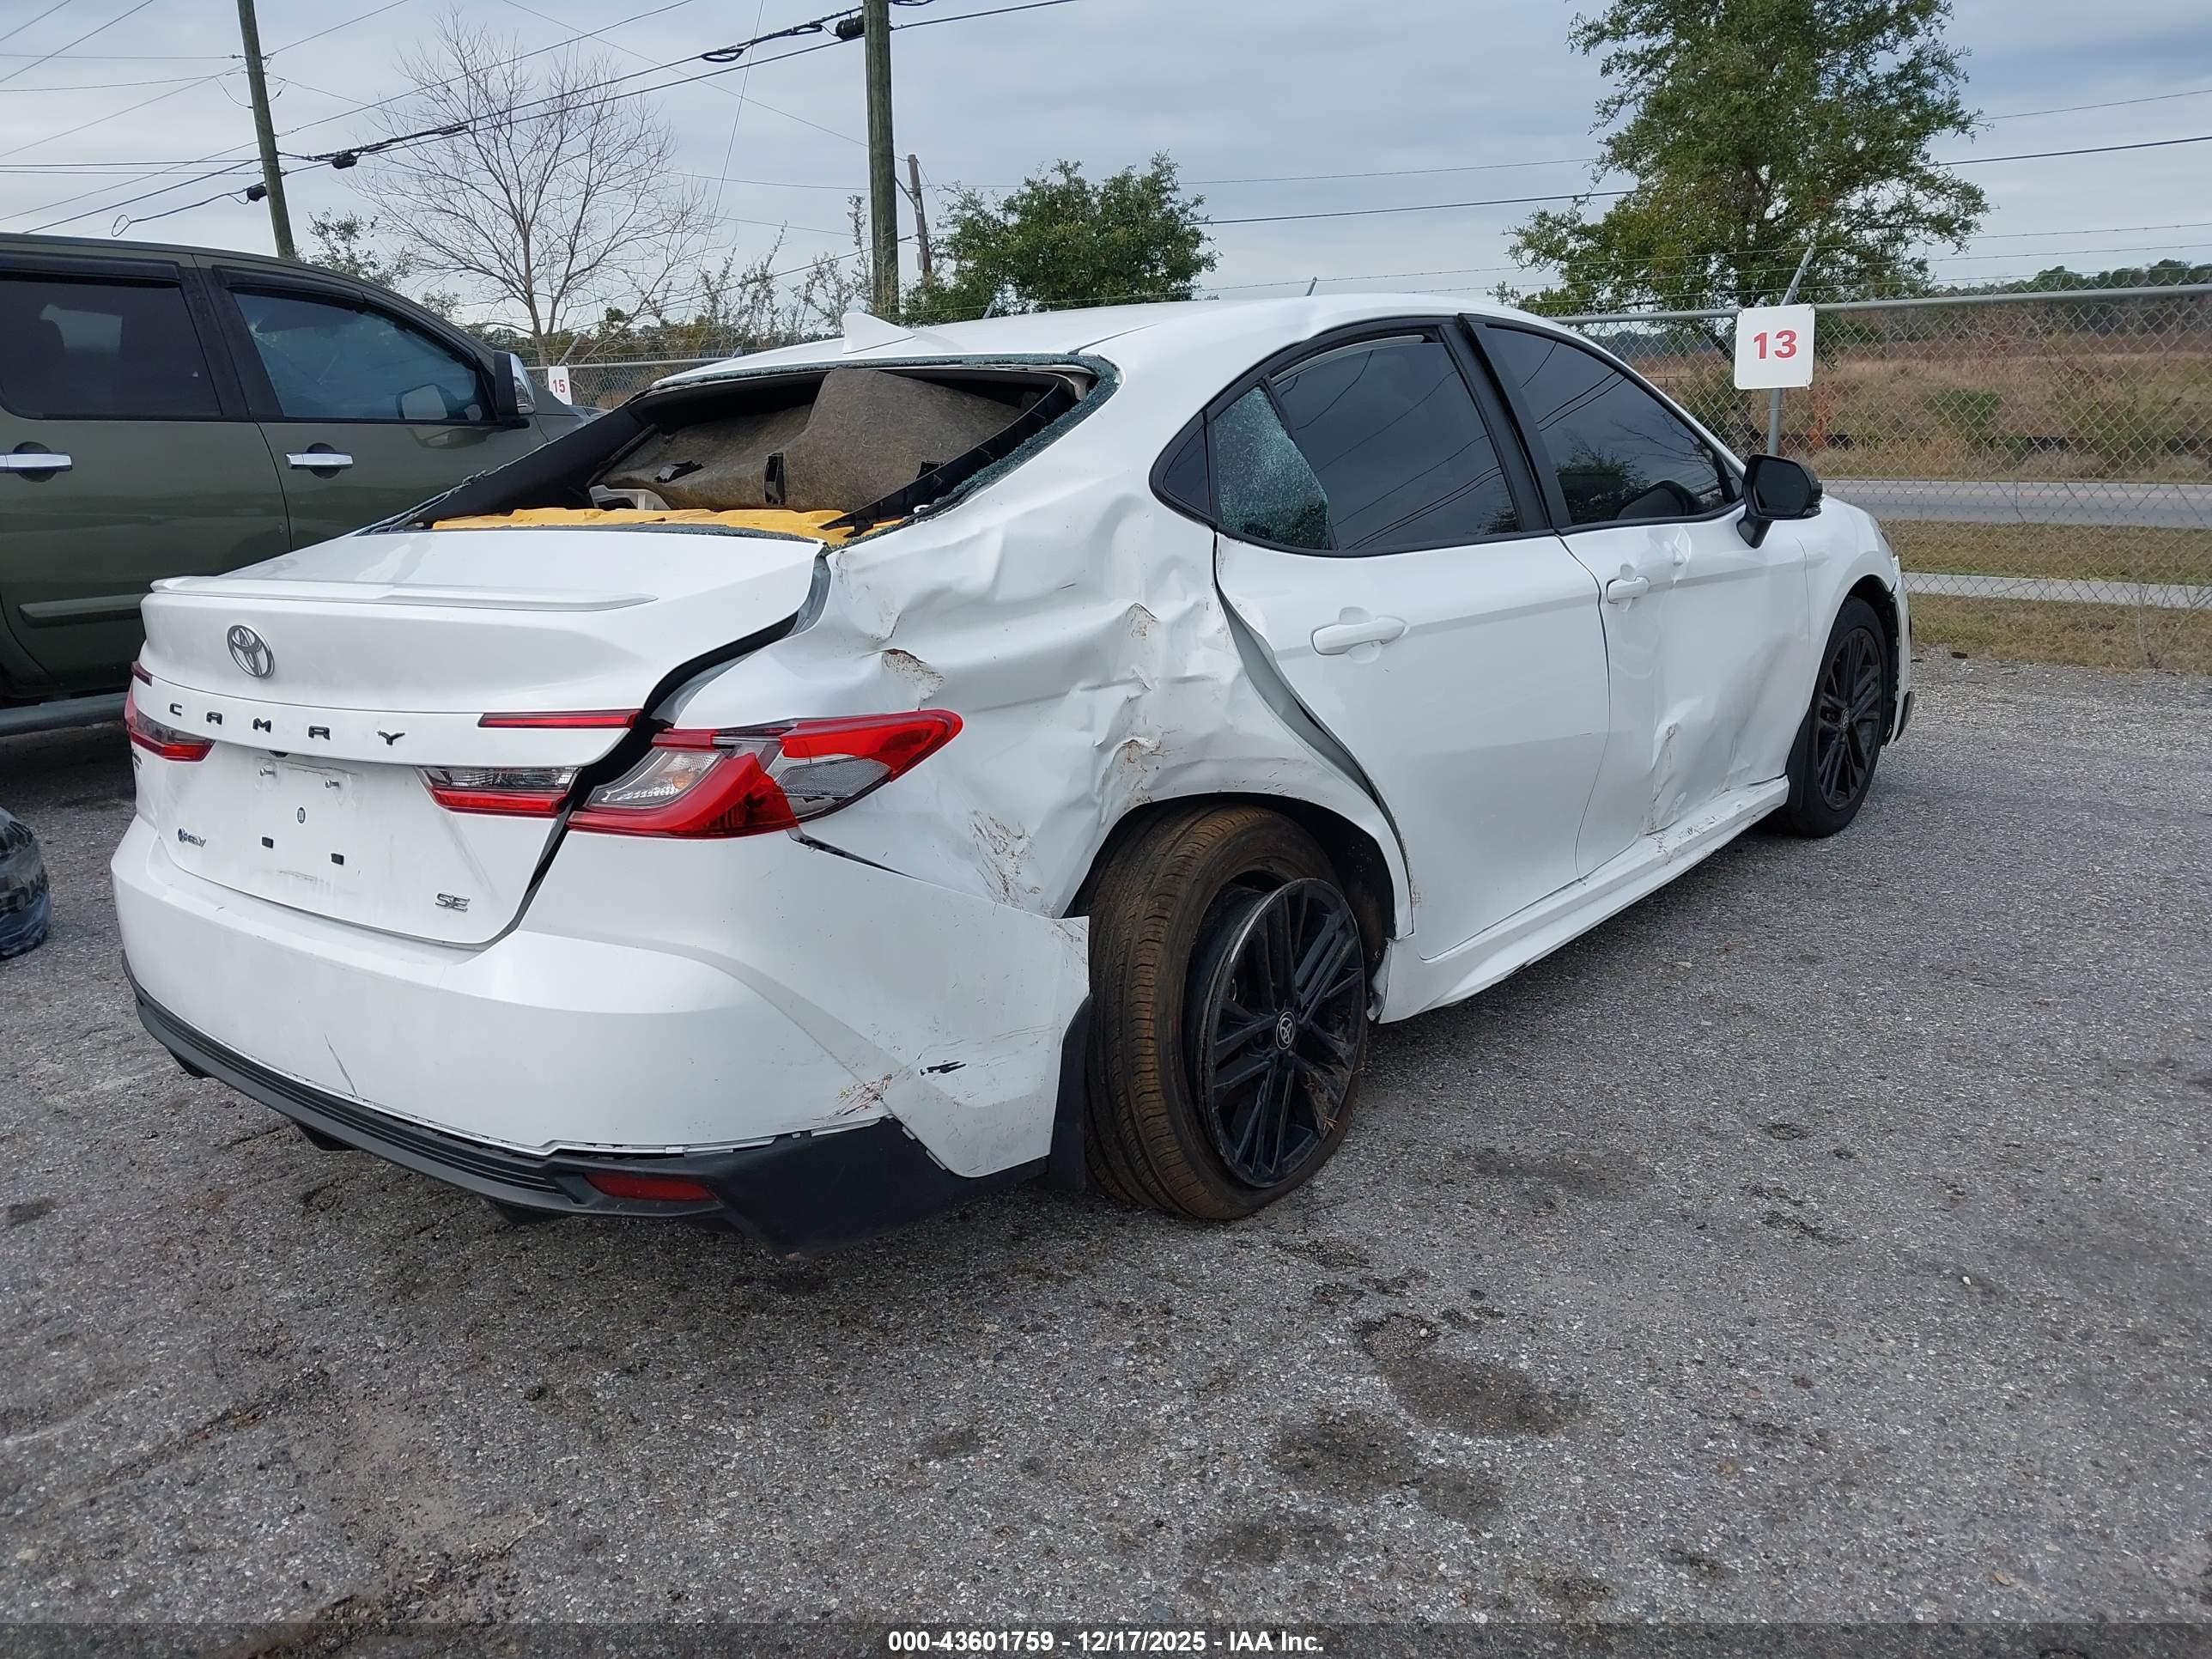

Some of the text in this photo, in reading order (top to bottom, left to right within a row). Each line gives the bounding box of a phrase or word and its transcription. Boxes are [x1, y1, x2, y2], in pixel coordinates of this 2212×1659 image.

[1753, 330, 1797, 359] 13
[553, 379, 566, 393] 15
[170, 702, 405, 746] CAMRY
[434, 892, 471, 913] SE
